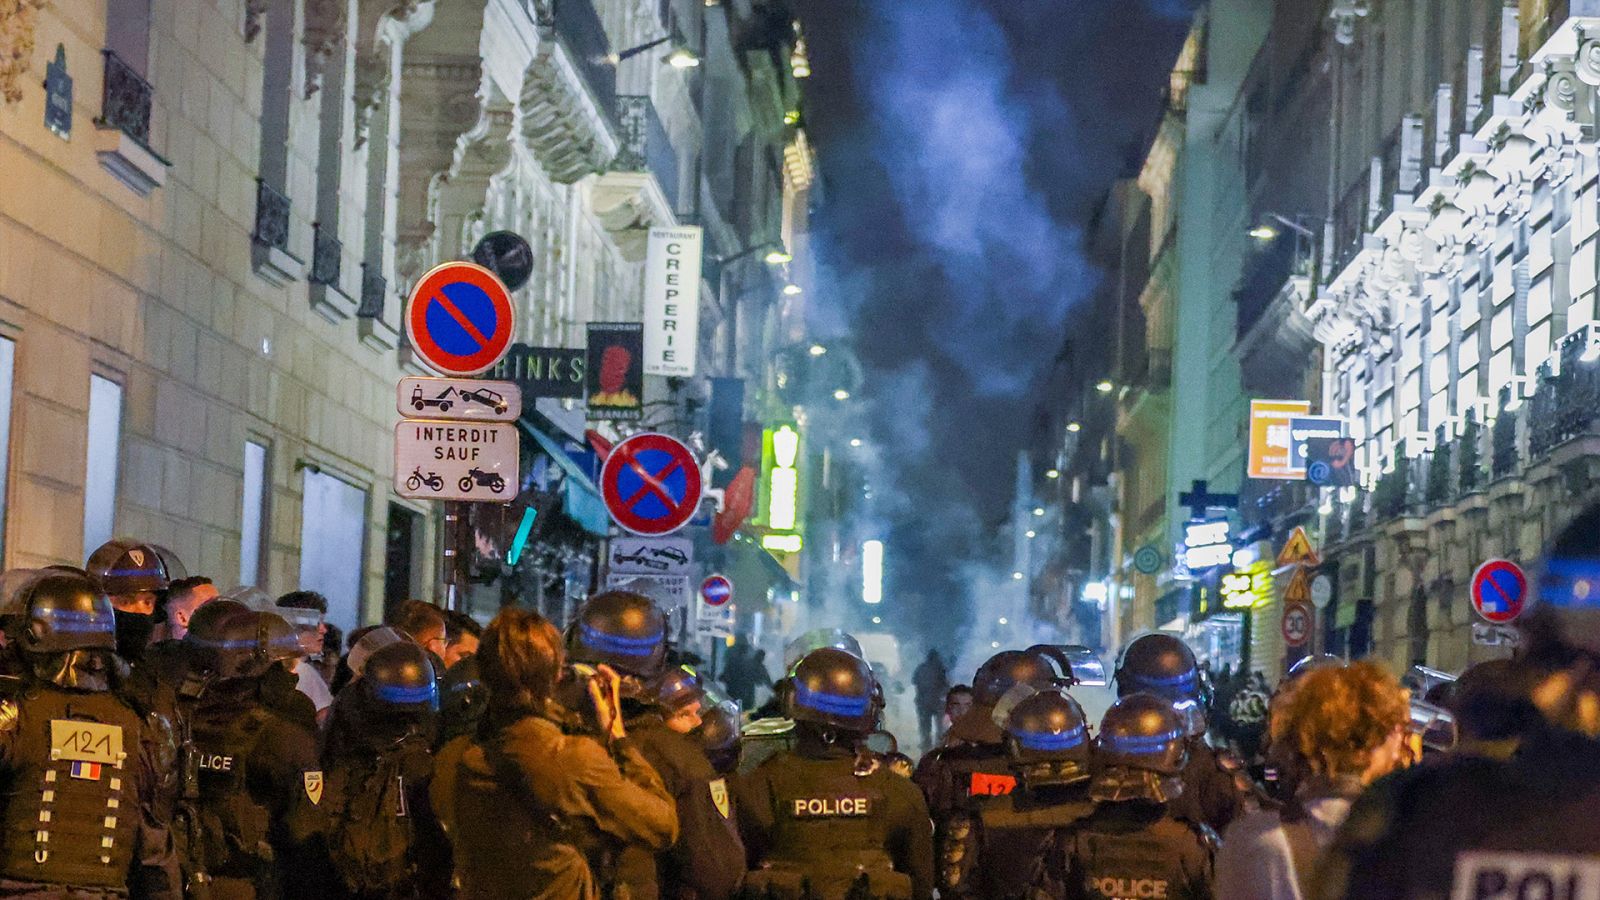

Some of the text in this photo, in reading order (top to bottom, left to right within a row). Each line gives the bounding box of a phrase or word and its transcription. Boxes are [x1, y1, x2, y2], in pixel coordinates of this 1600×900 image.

[653, 231, 696, 239] RESTAURANT
[662, 243, 681, 362] CREPERIE
[494, 355, 583, 382] RINKS
[416, 427, 498, 443] INTERDIT
[434, 446, 480, 461] SAUF
[63, 730, 111, 757] 121
[199, 754, 233, 770] LICE
[795, 798, 867, 815] POLICE
